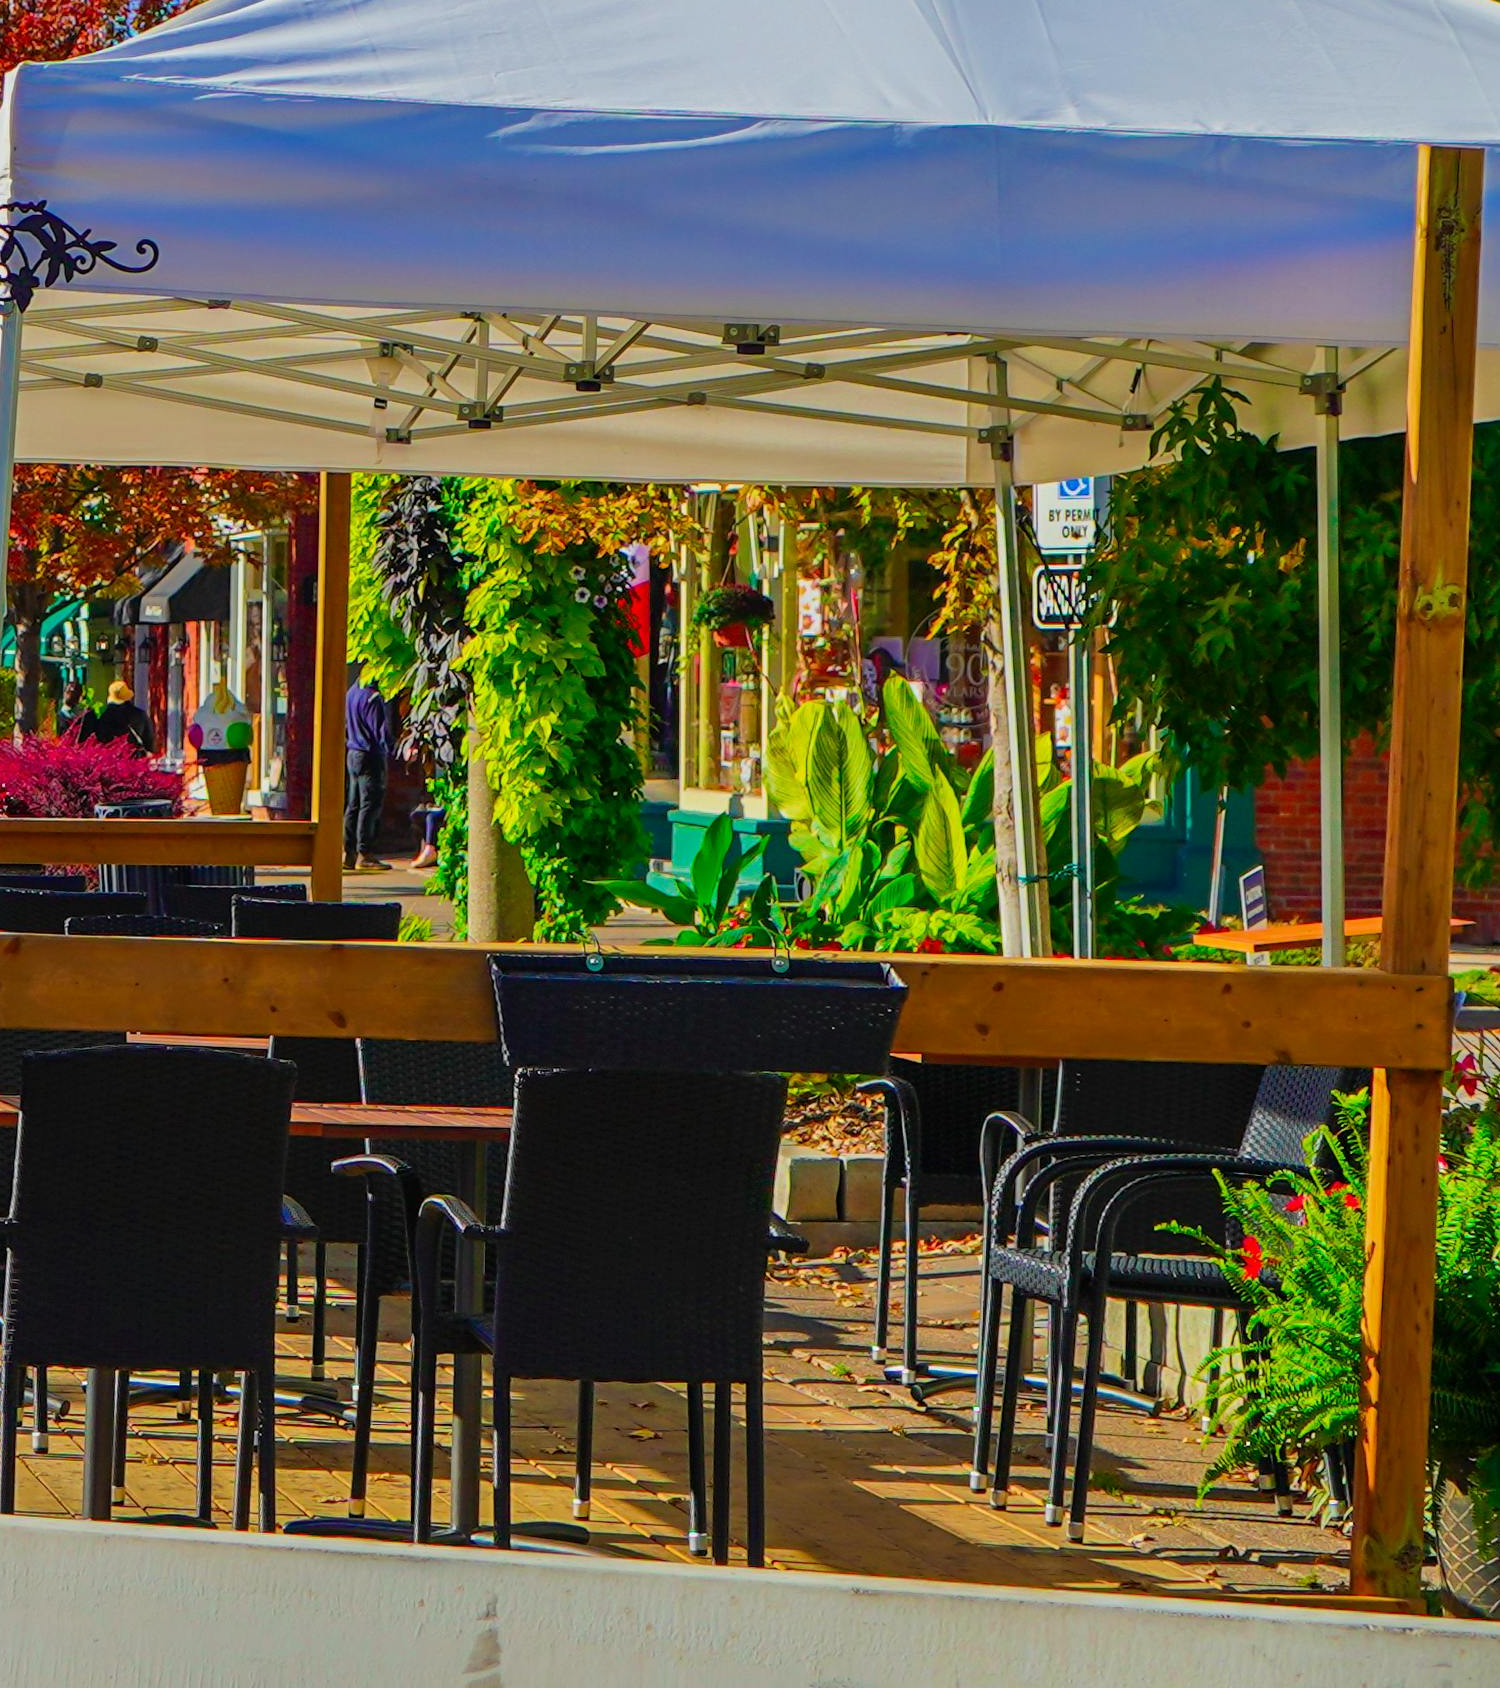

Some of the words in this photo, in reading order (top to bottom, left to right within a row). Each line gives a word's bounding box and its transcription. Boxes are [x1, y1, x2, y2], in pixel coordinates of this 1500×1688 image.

[1048, 509, 1062, 522] BY
[1065, 508, 1100, 521] PERMIT
[1061, 525, 1088, 539] ONLY
